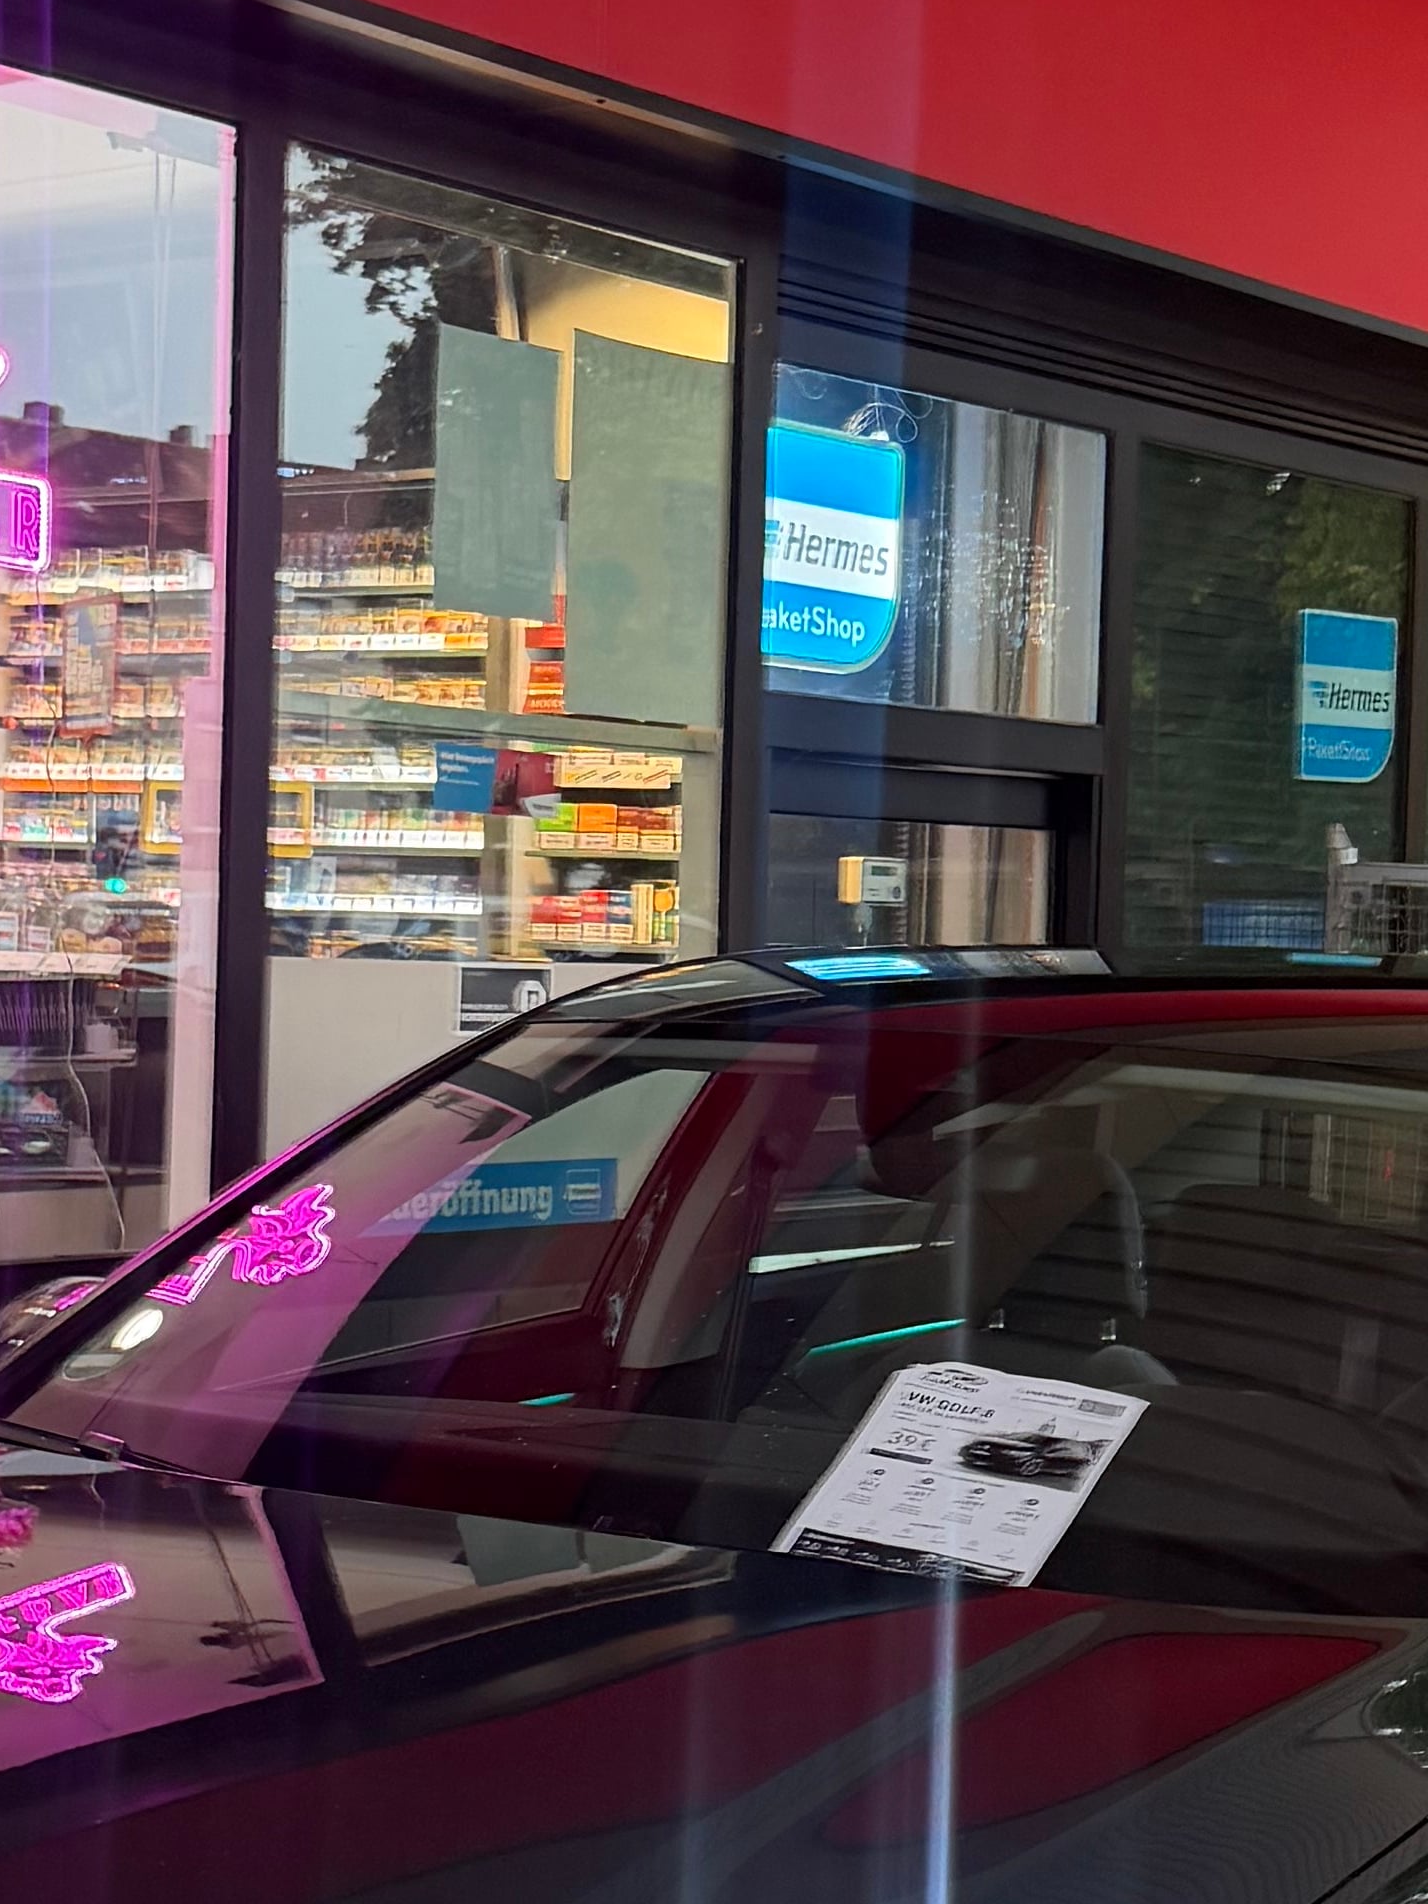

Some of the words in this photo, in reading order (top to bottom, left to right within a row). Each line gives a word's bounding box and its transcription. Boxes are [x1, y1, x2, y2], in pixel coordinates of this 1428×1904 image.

[782, 522, 889, 576] Hermes
[762, 601, 866, 648] aketShop
[1328, 682, 1391, 713] Hermes
